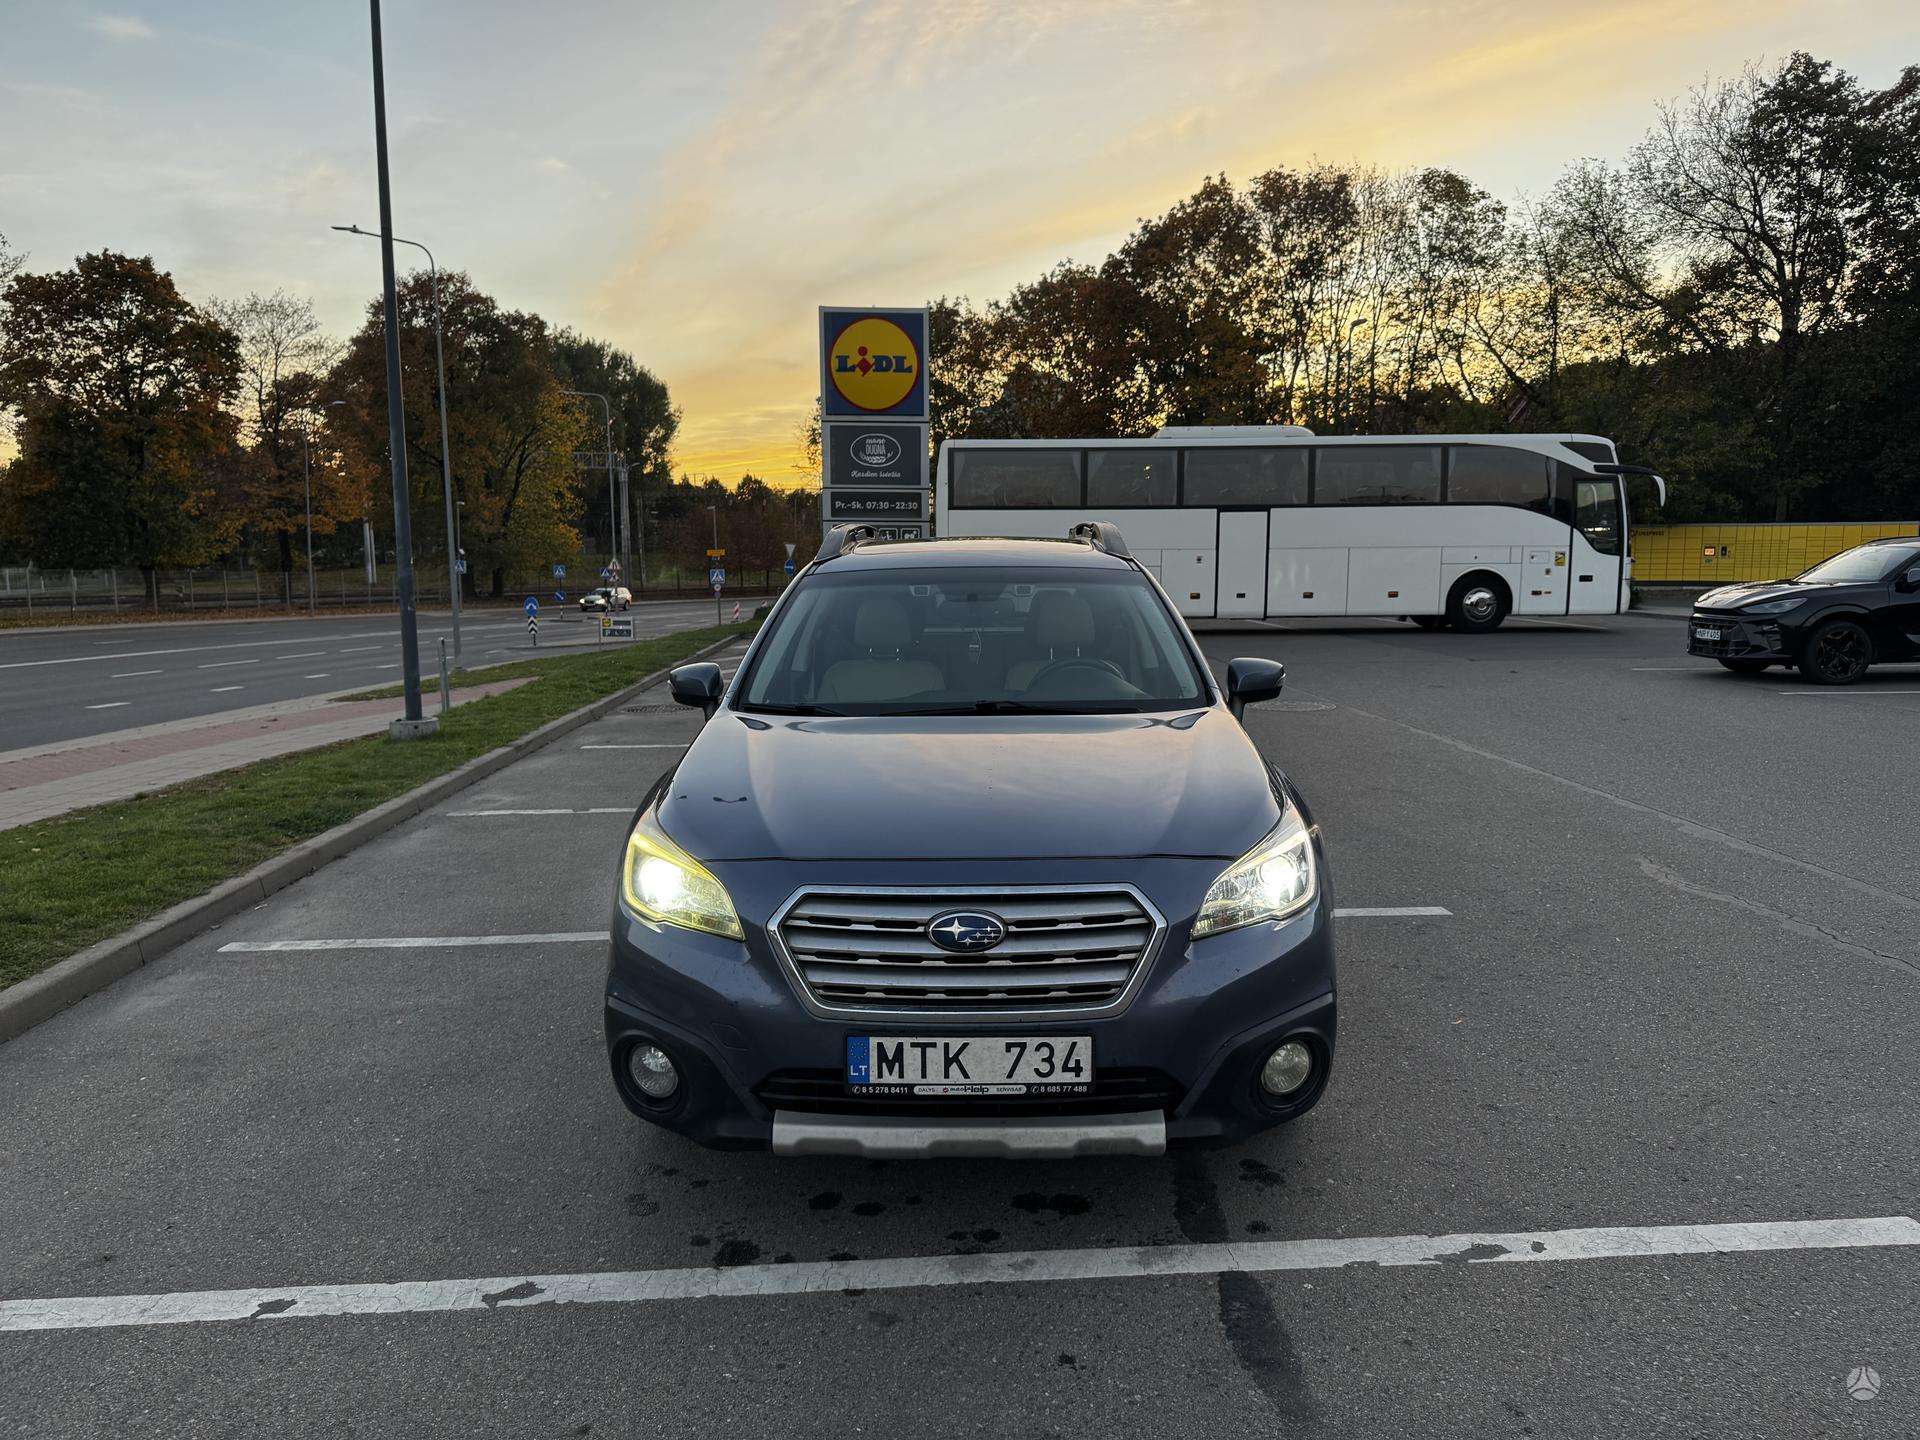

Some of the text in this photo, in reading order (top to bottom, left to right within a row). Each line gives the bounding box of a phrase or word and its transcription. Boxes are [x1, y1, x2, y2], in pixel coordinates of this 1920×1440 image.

[850, 1065, 868, 1076] LT
[876, 1041, 1084, 1080] MTK 734
